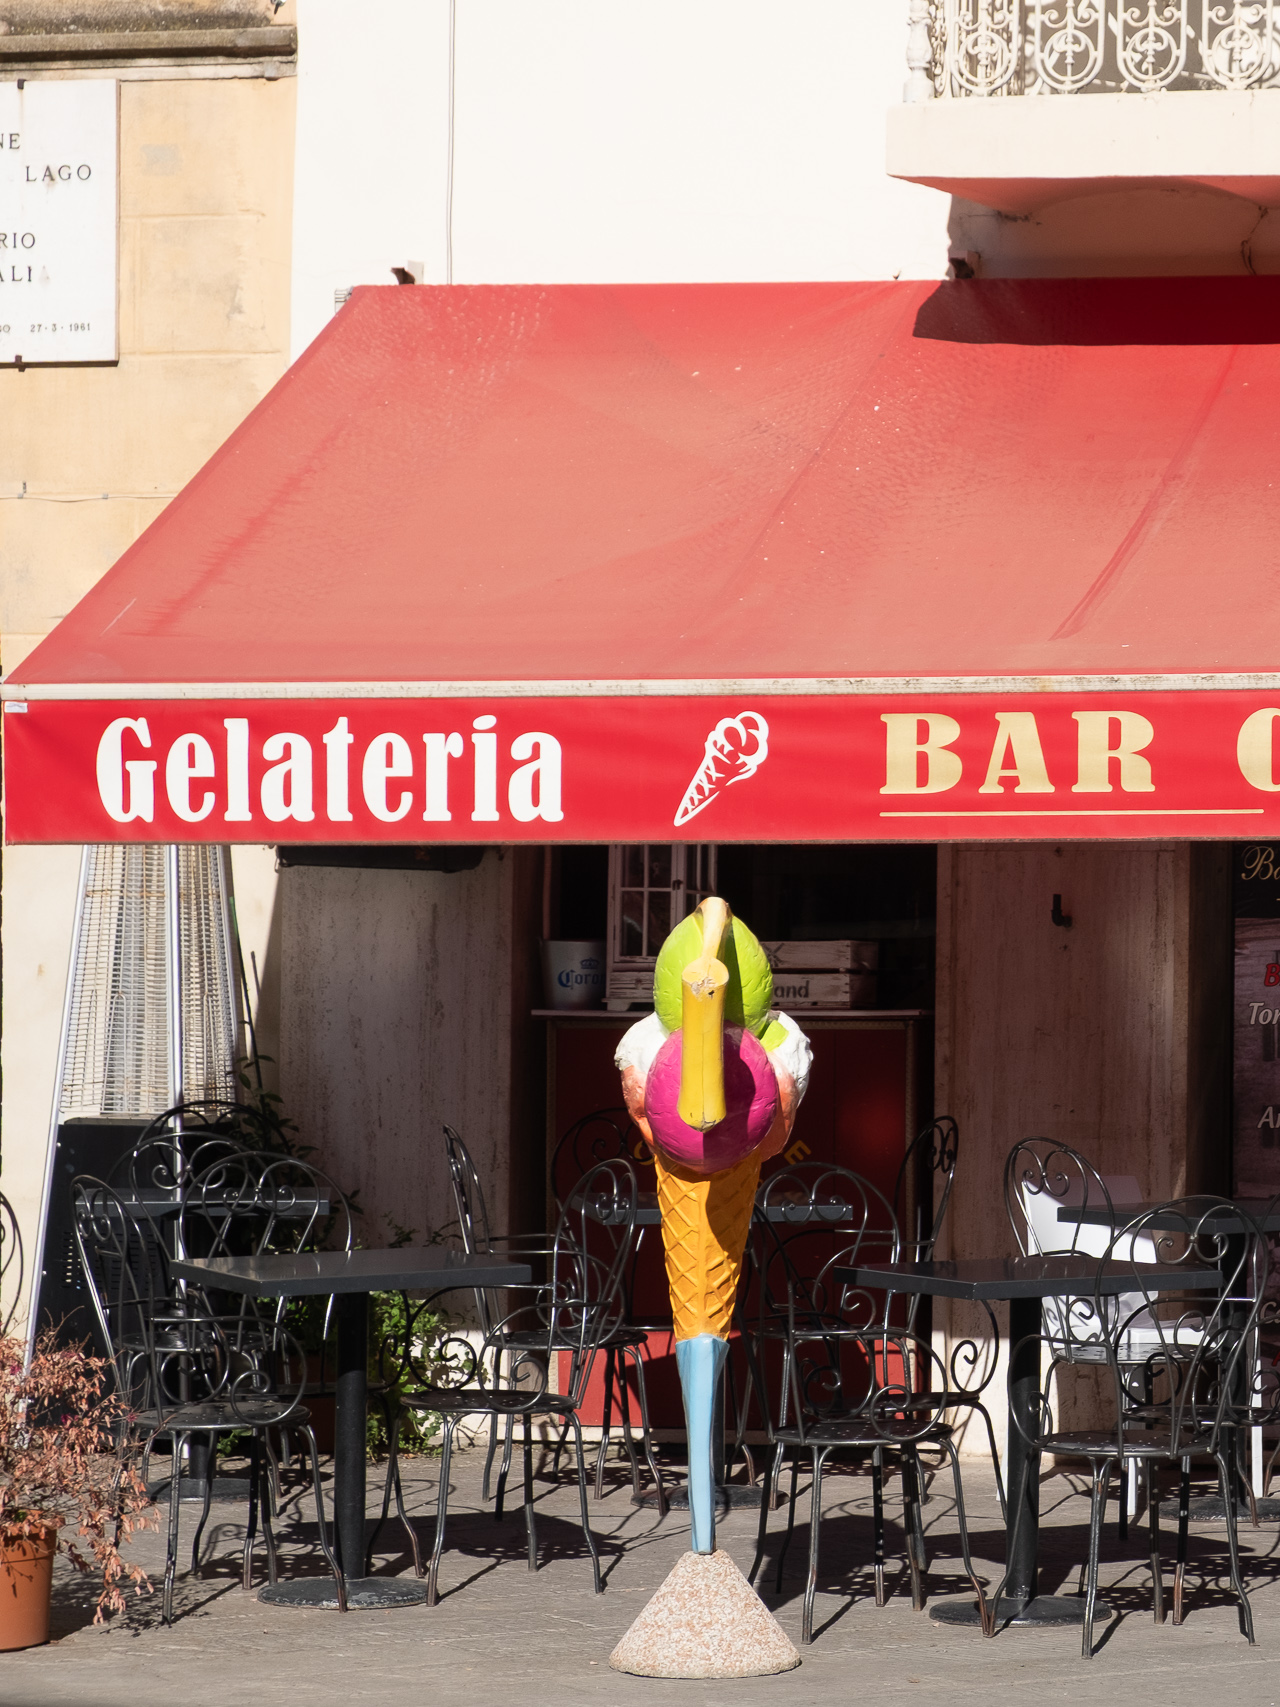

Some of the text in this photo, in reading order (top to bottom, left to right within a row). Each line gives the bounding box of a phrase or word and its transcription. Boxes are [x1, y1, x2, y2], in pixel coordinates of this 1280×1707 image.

[26, 164, 92, 182] LAGO
[95, 714, 564, 823] Gelateria
[879, 710, 1156, 794] BAR
